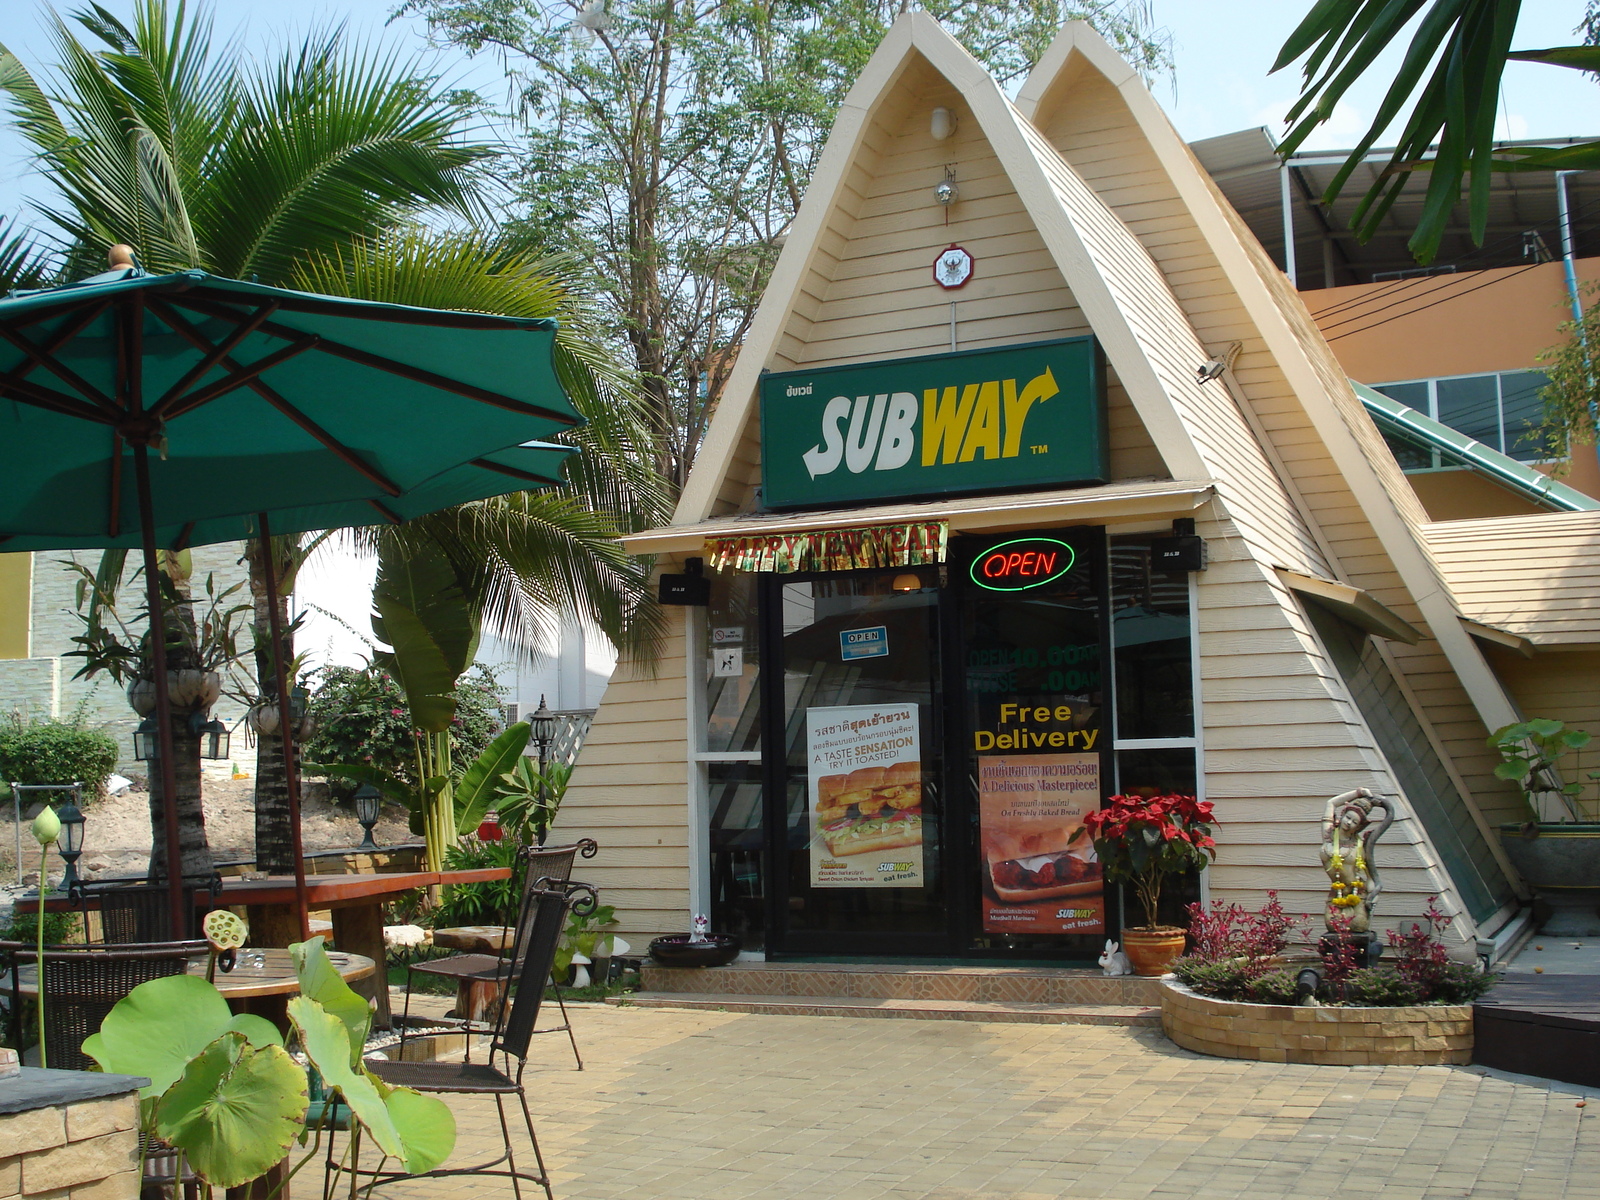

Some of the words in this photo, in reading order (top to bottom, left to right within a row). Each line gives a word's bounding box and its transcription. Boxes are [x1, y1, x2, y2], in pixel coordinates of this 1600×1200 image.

[786, 382, 813, 397] ซับเวย์
[803, 365, 1060, 481] SUBWAY
[1030, 444, 1048, 455] TM
[717, 535, 800, 559] HAPPY
[807, 530, 864, 557] NEW
[871, 523, 942, 553] YEAR
[984, 551, 1057, 578] OPEN
[848, 631, 878, 642] OPEN
[969, 649, 1008, 668] OPEN
[1000, 703, 1072, 724] Free
[975, 728, 1099, 751] Delivery
[814, 755, 822, 764] A
[824, 748, 852, 762] TASTE
[854, 736, 914, 756] SENSATION
[829, 760, 844, 769] TRY
[846, 759, 853, 767] IT
[855, 750, 900, 764] TOASTED!
[982, 780, 989, 793] A
[991, 780, 1035, 793] Delicious
[1037, 778, 1098, 794] Masterpiece!
[1013, 809, 1036, 817] Freshly
[1060, 808, 1080, 816] Bread
[878, 861, 914, 872] SUBWAY
[883, 874, 895, 882] eat
[897, 871, 918, 880] fresh.
[1056, 908, 1096, 919] SUBWAY
[1062, 922, 1076, 930] eat
[1077, 919, 1101, 928] fresh.
